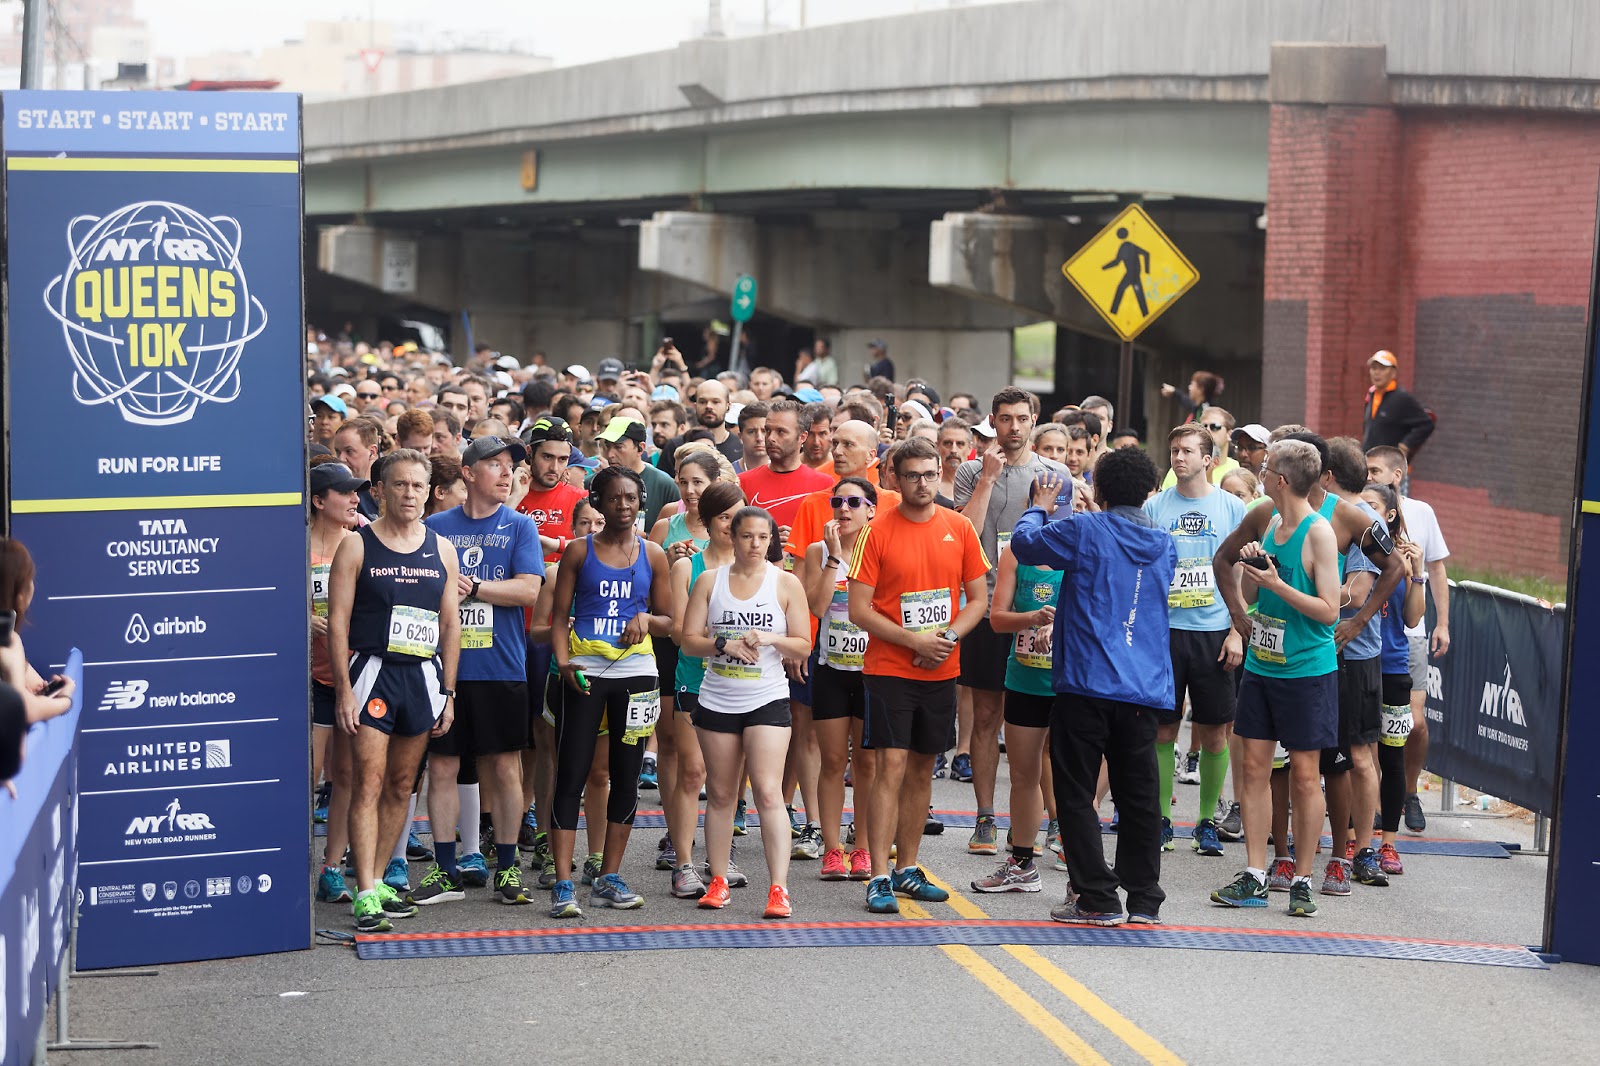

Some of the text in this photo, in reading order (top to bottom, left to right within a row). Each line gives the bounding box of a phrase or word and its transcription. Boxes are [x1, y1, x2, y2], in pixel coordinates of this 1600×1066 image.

[18, 110, 288, 131] START START START
[76, 266, 236, 322] QUEENS
[127, 324, 188, 367] 10K
[98, 456, 221, 474] RUN FOR LIFE
[139, 519, 188, 536] TATA
[106, 538, 219, 556] CONSULTANCY
[444, 534, 510, 549] ANSAS CITY
[128, 558, 200, 576] SERVICES
[370, 566, 440, 578] FRONT RUNNERS
[314, 580, 322, 593] B
[1180, 572, 1208, 587] 2444
[600, 580, 632, 598] CAN
[608, 600, 619, 617] &
[904, 605, 947, 624] E 3266
[154, 616, 206, 635] airbnb
[738, 612, 773, 627] NBR
[393, 622, 434, 643] D 6290
[1018, 635, 1024, 647] E
[1252, 627, 1277, 650] E 2157
[829, 635, 867, 652] D 290
[150, 691, 236, 708] new balance
[631, 707, 638, 719] E
[128, 741, 201, 757] UNITED
[104, 757, 202, 776] AIRLINES
[164, 836, 184, 844] ROAD
[184, 834, 216, 842] RUNNERS
